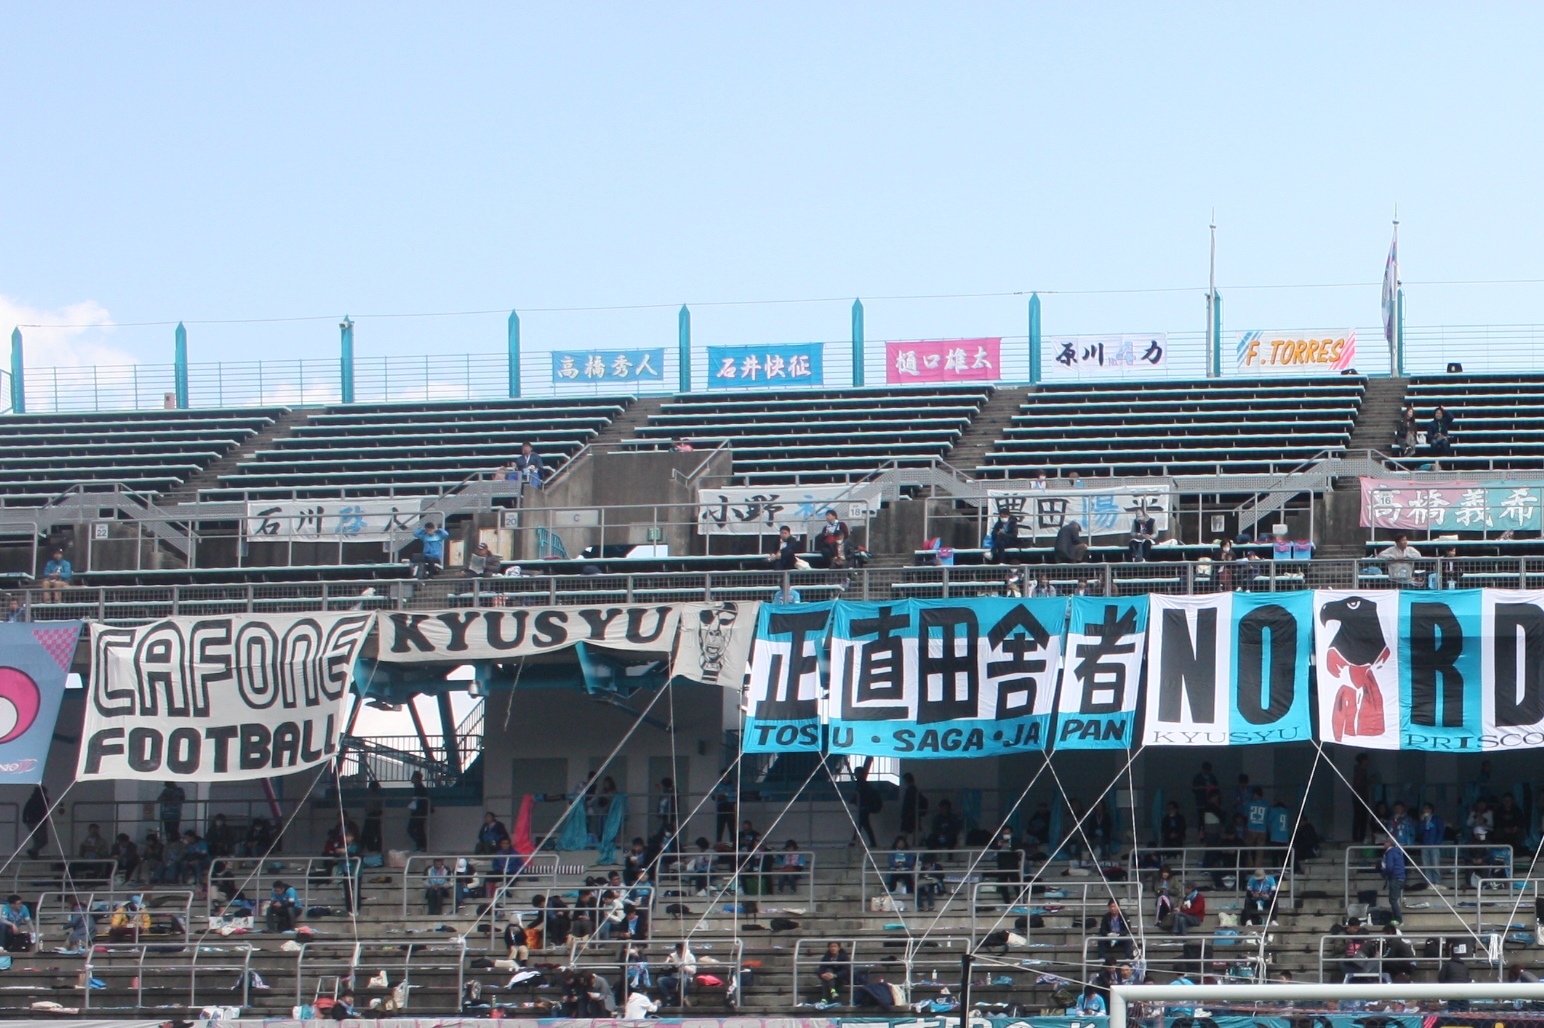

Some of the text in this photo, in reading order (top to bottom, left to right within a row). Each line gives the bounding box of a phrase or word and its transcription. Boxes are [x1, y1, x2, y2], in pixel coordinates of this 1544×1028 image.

[556, 353, 659, 380] 高橋秀人
[895, 346, 994, 377] 樋口雄太
[1055, 341, 1105, 367] 原川
[1140, 339, 1164, 365] 力
[716, 353, 812, 381] 石井快征
[851, 508, 861, 516] 18
[1366, 484, 1540, 528] 高橋義希
[1380, 497, 1391, 506] 16
[96, 529, 107, 537] 22
[506, 519, 517, 527] 20
[390, 605, 673, 654] KYUSYU
[753, 603, 1138, 723] 正直田舎者
[85, 719, 337, 774] FOOTBALL
[1153, 726, 1299, 744] KYUSYU
[1250, 806, 1266, 822] 29
